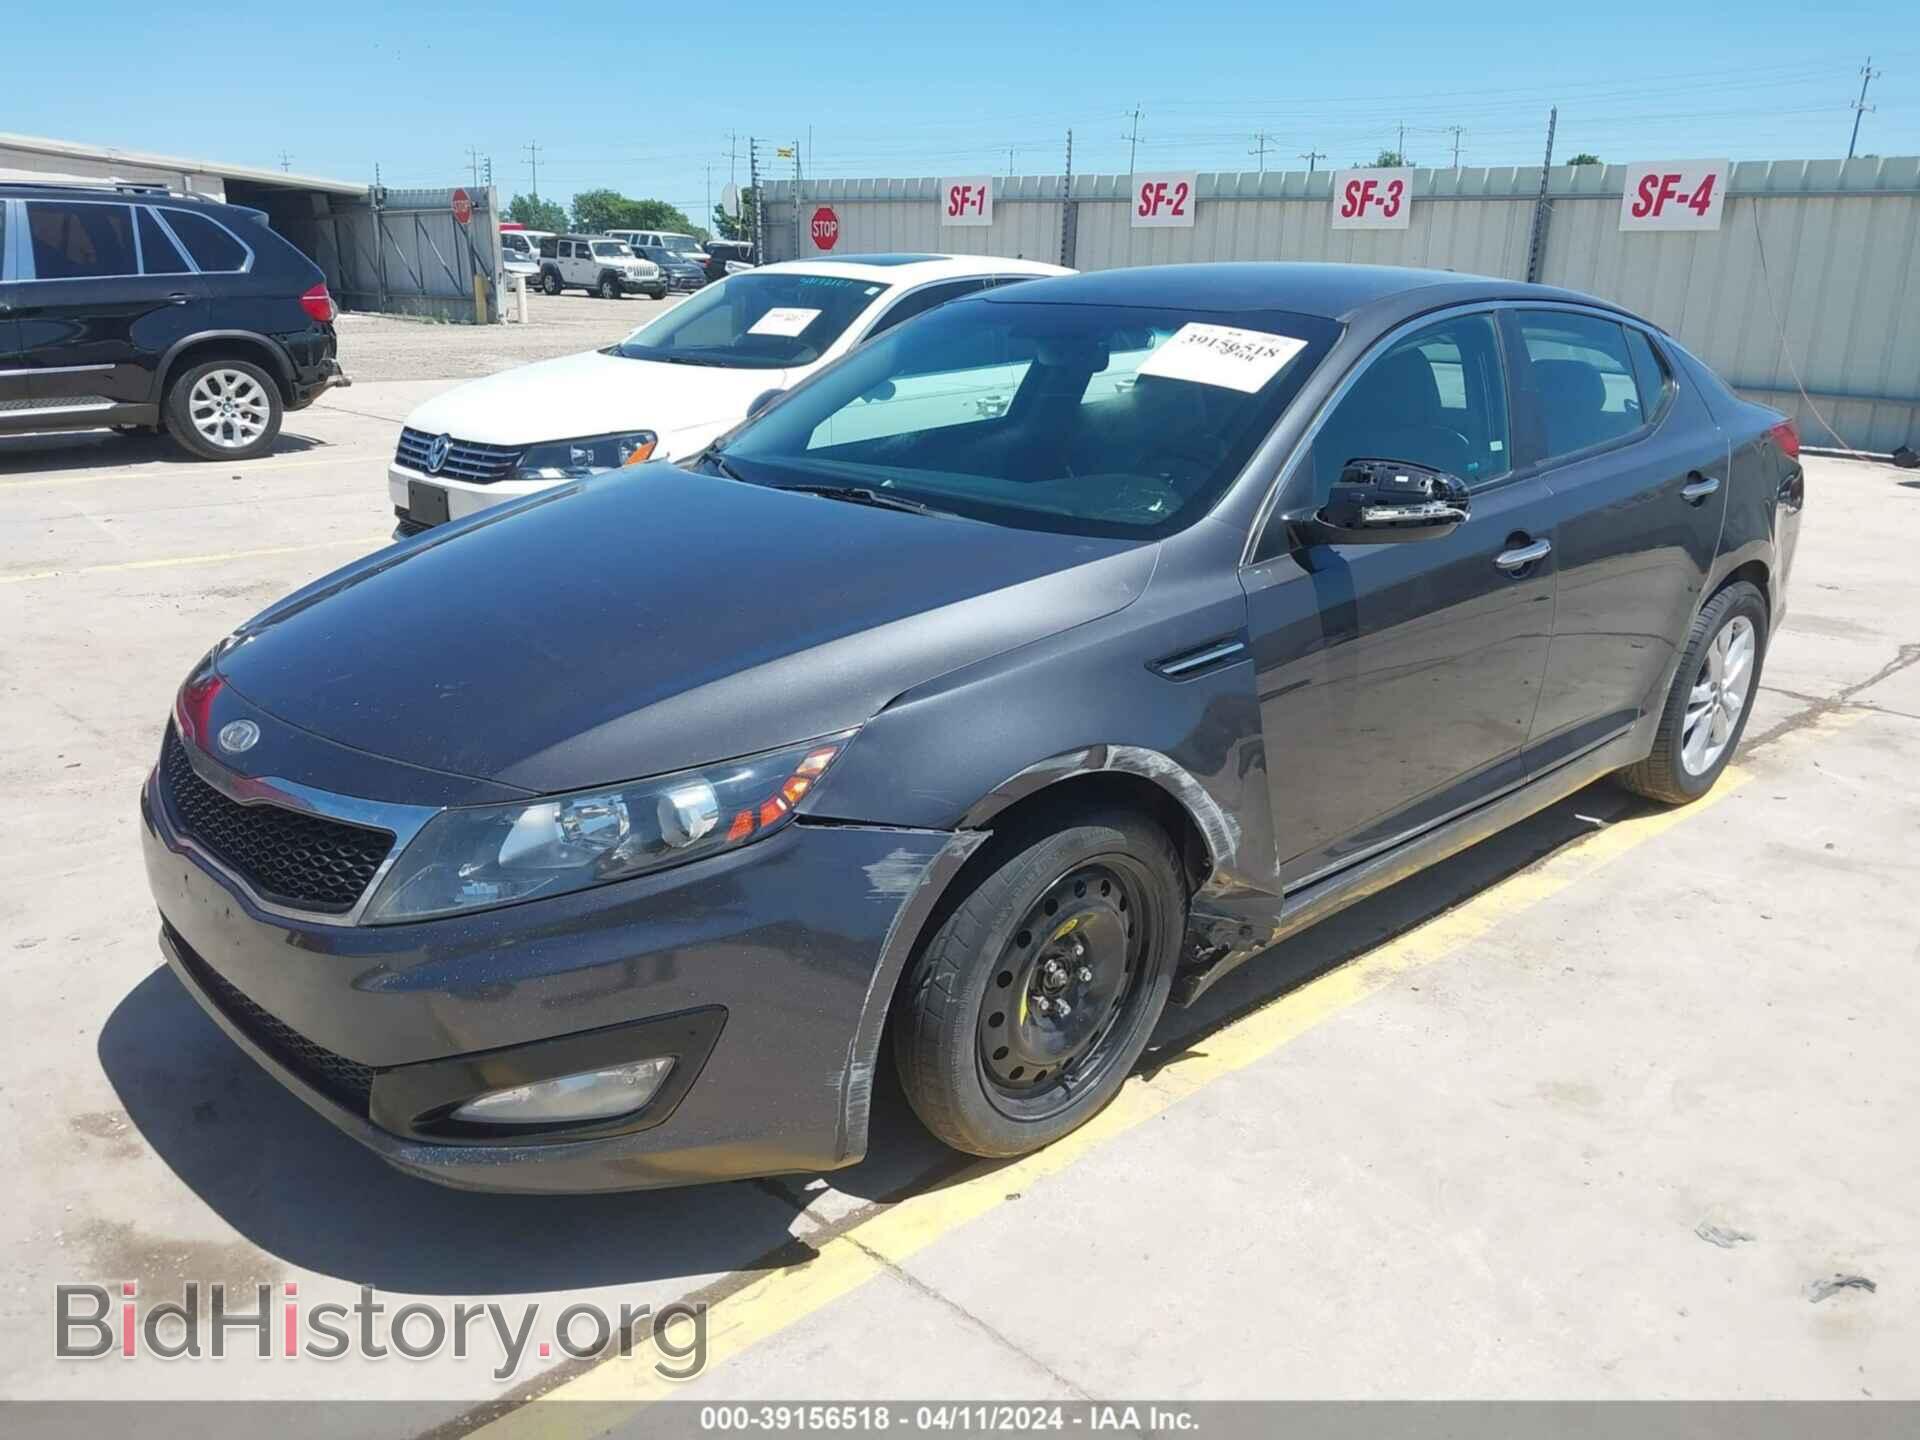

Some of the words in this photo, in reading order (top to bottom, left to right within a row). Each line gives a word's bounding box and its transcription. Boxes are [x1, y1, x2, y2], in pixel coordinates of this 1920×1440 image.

[950, 186, 984, 215] SF-1
[1139, 183, 1188, 217] SF-2
[1341, 180, 1404, 218] SF-3
[1631, 174, 1716, 218] SF-4
[812, 220, 838, 238] STOP
